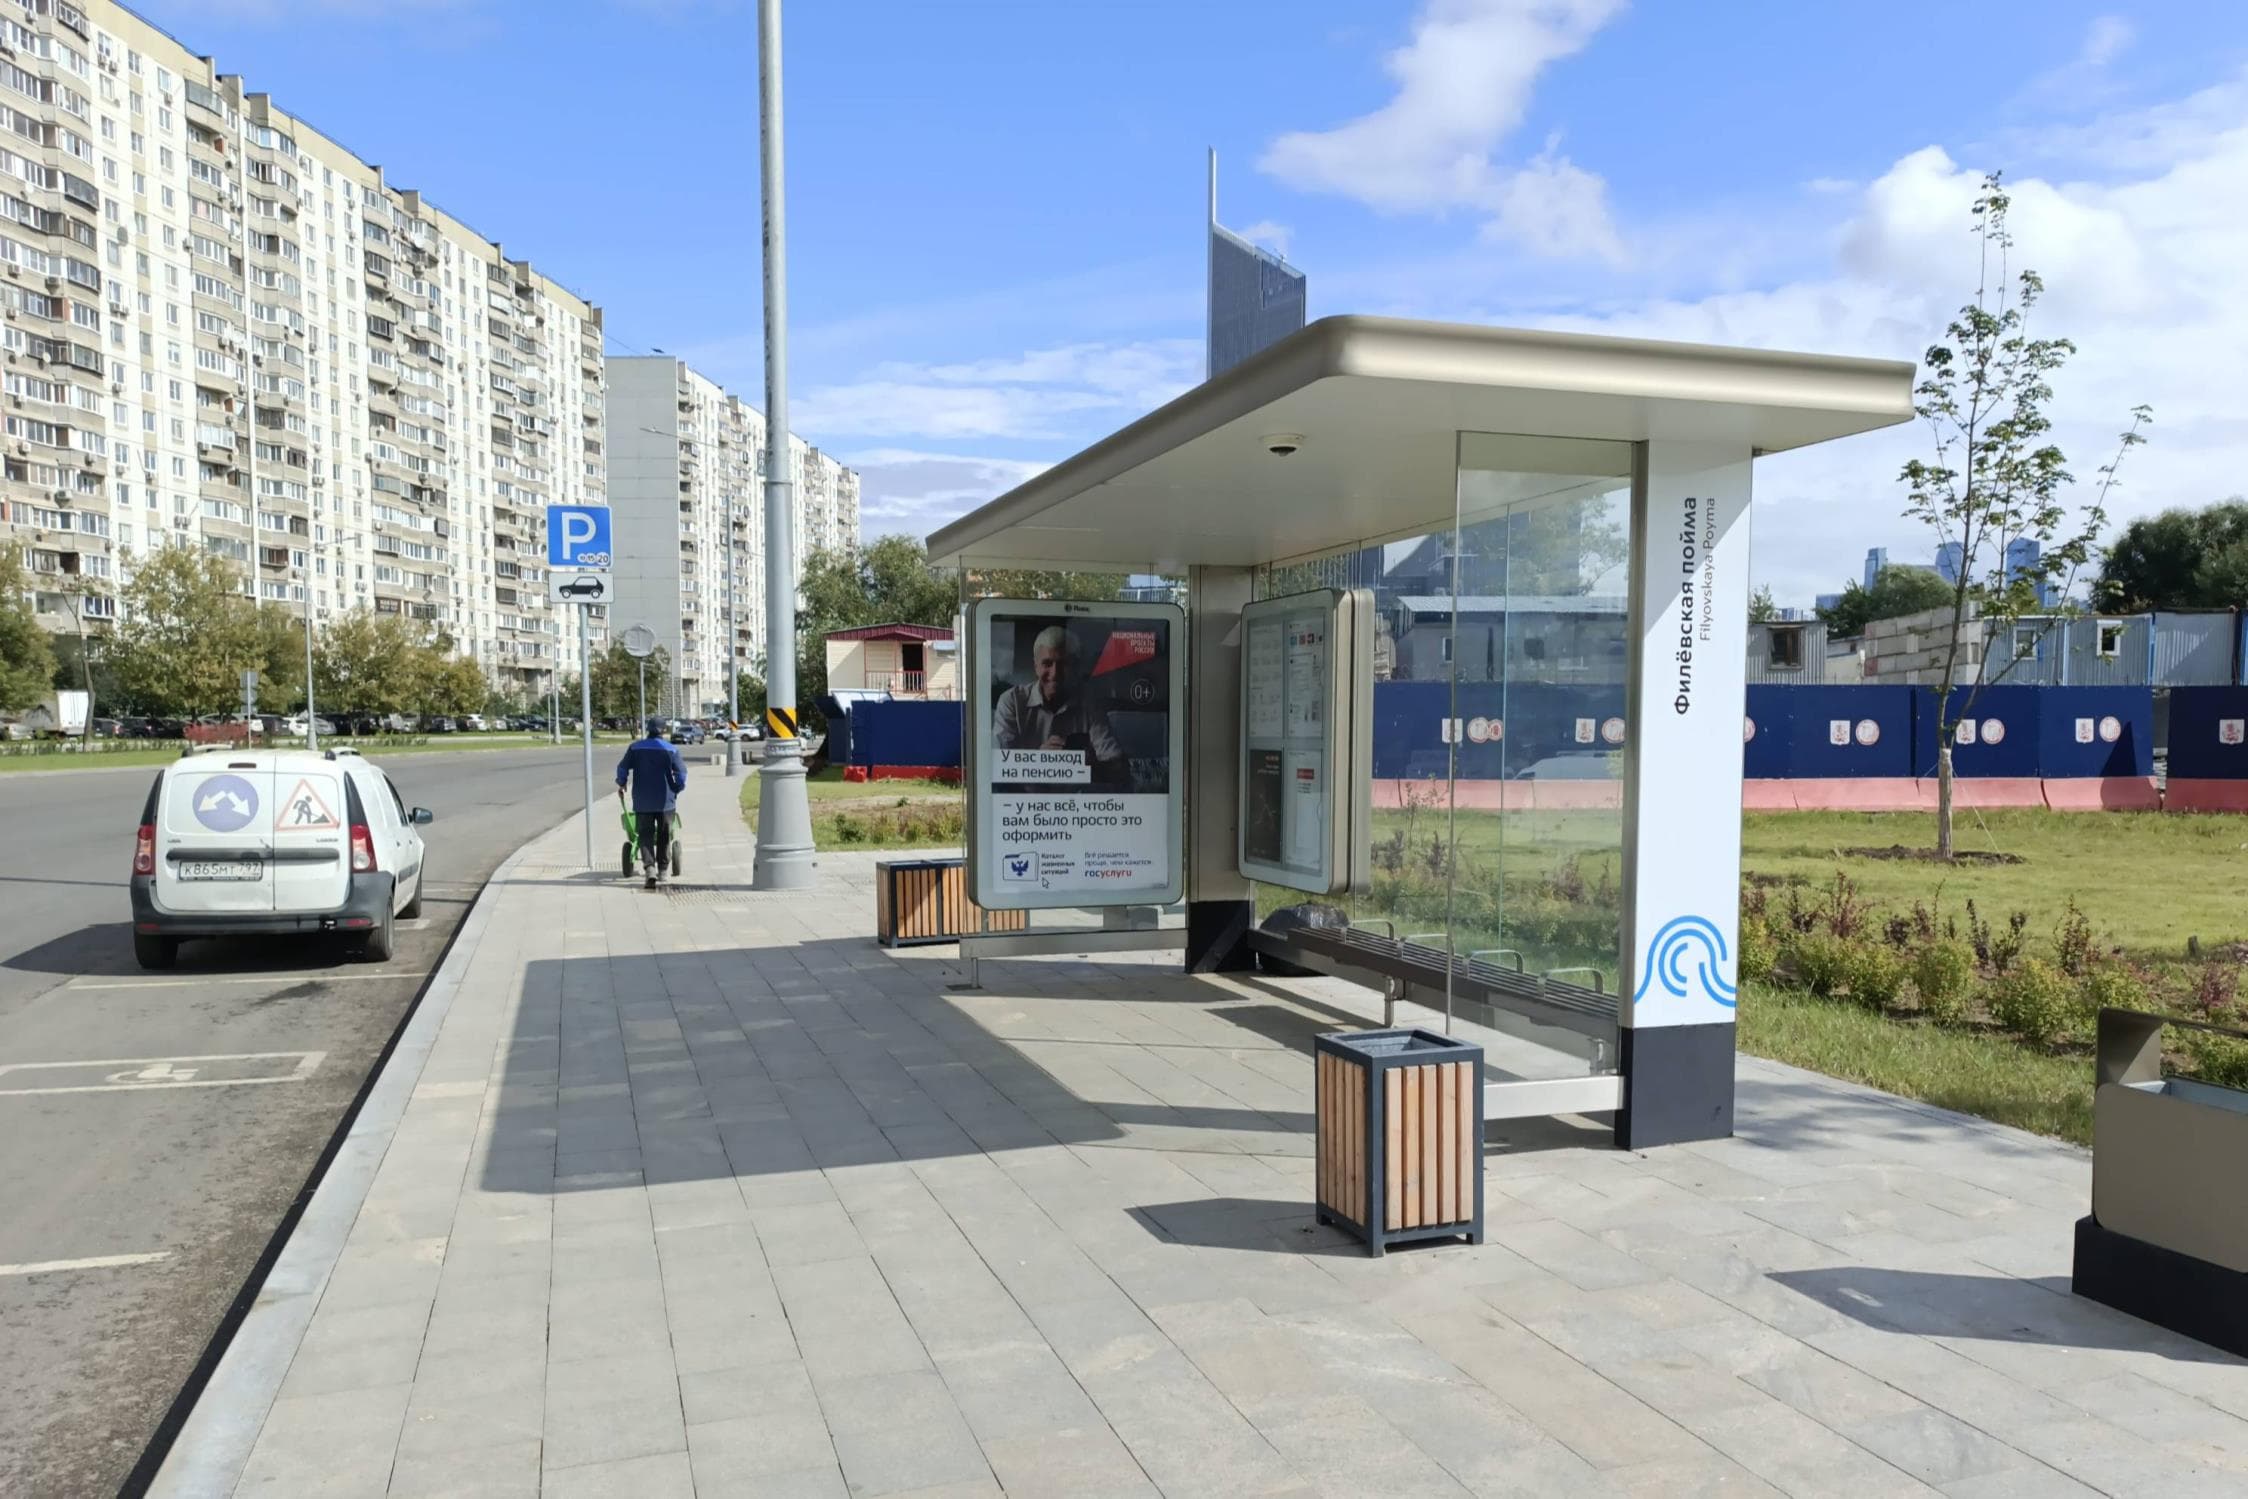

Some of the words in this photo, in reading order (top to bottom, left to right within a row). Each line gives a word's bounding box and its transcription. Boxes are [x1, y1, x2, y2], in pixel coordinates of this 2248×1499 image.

[1702, 498, 1717, 550] Poyma
[561, 512, 597, 560] P
[1679, 497, 1697, 574] пойма
[597, 554, 609, 564] 20
[1700, 554, 1715, 641] Filyovskaya
[1674, 581, 1694, 715] Филёвская
[1134, 684, 1151, 699] 0+
[1001, 750, 1011, 763] У
[1014, 752, 1037, 763] вас
[1040, 752, 1083, 765] выход
[1001, 768, 1018, 778] на
[1022, 767, 1074, 778] пенсию
[1016, 801, 1024, 815] у
[1027, 801, 1051, 812] нас
[1054, 799, 1080, 813] всё,
[1083, 798, 1125, 812] чтобы
[1002, 816, 1029, 826] вам
[1033, 812, 1068, 826] было
[1072, 815, 1118, 829] просто
[1120, 815, 1143, 826] это
[1002, 829, 1073, 844] оформить
[184, 862, 235, 876] К865МТ
[238, 862, 260, 874] 797
